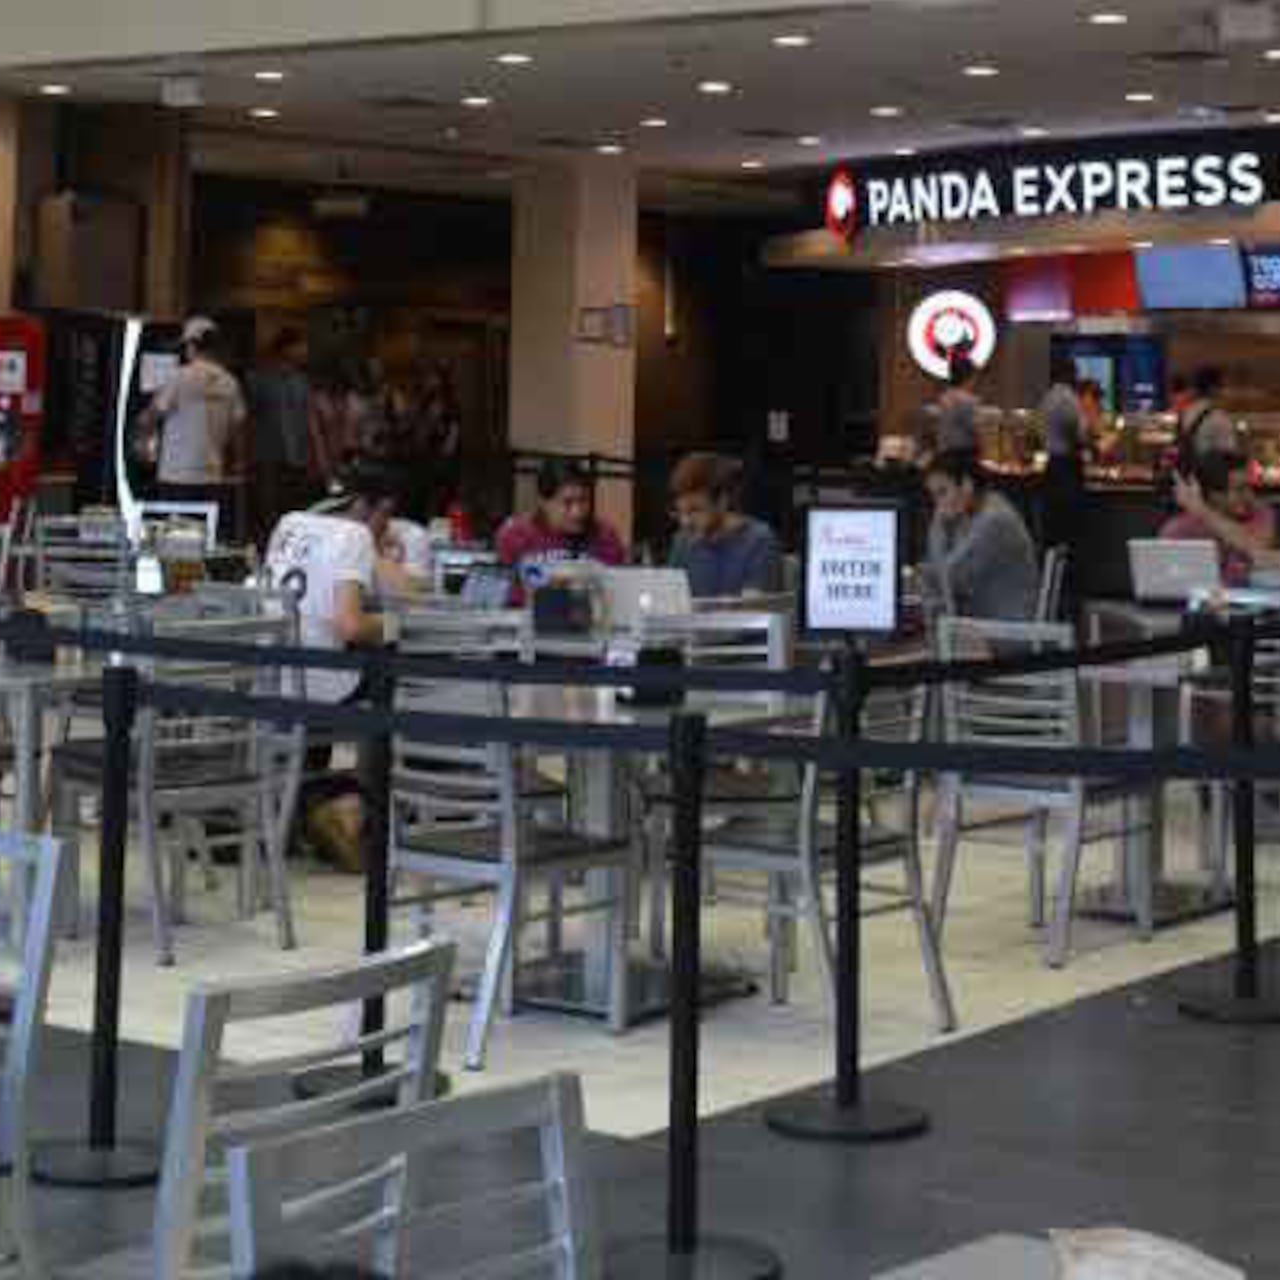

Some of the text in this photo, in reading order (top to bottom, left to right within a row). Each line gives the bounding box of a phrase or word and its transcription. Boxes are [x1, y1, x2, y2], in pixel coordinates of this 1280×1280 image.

[867, 151, 1264, 226] PANDA EXPRESS
[826, 583, 873, 601] HERE
